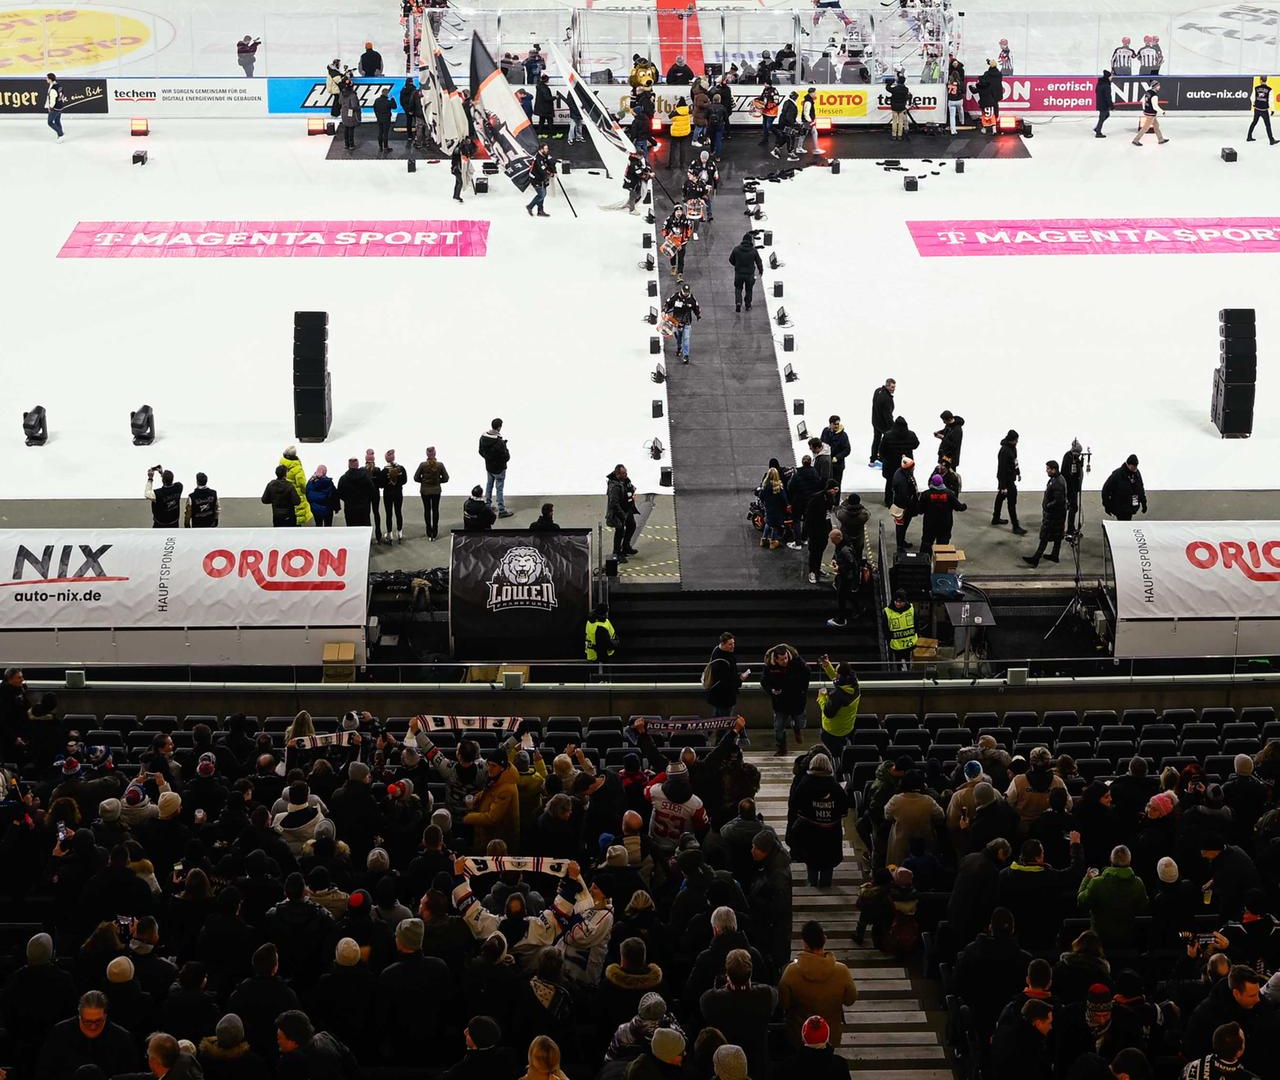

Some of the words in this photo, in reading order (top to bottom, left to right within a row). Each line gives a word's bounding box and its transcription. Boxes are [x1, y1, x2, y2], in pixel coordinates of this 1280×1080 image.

[19, 35, 144, 64] LOTTO
[1047, 81, 1093, 91] erotisch
[819, 94, 863, 106] LOTTO
[1187, 90, 1248, 98] auto-nix.de
[1043, 96, 1092, 109] shoppen
[818, 107, 843, 116] Hessen
[133, 231, 329, 246] MAGENTA
[334, 230, 462, 246] SPORT
[977, 229, 1173, 243] MAGENTA
[12, 545, 114, 578] NIX
[1132, 528, 1155, 604] HAUPTSPONSOR
[157, 535, 177, 614] HAUPTSPONSOR
[201, 547, 349, 592] ORION
[15, 589, 101, 601] auto-nix.de
[489, 580, 556, 605] LÖWEN
[686, 719, 736, 731] MANNHEI
[815, 810, 832, 818] NIX
